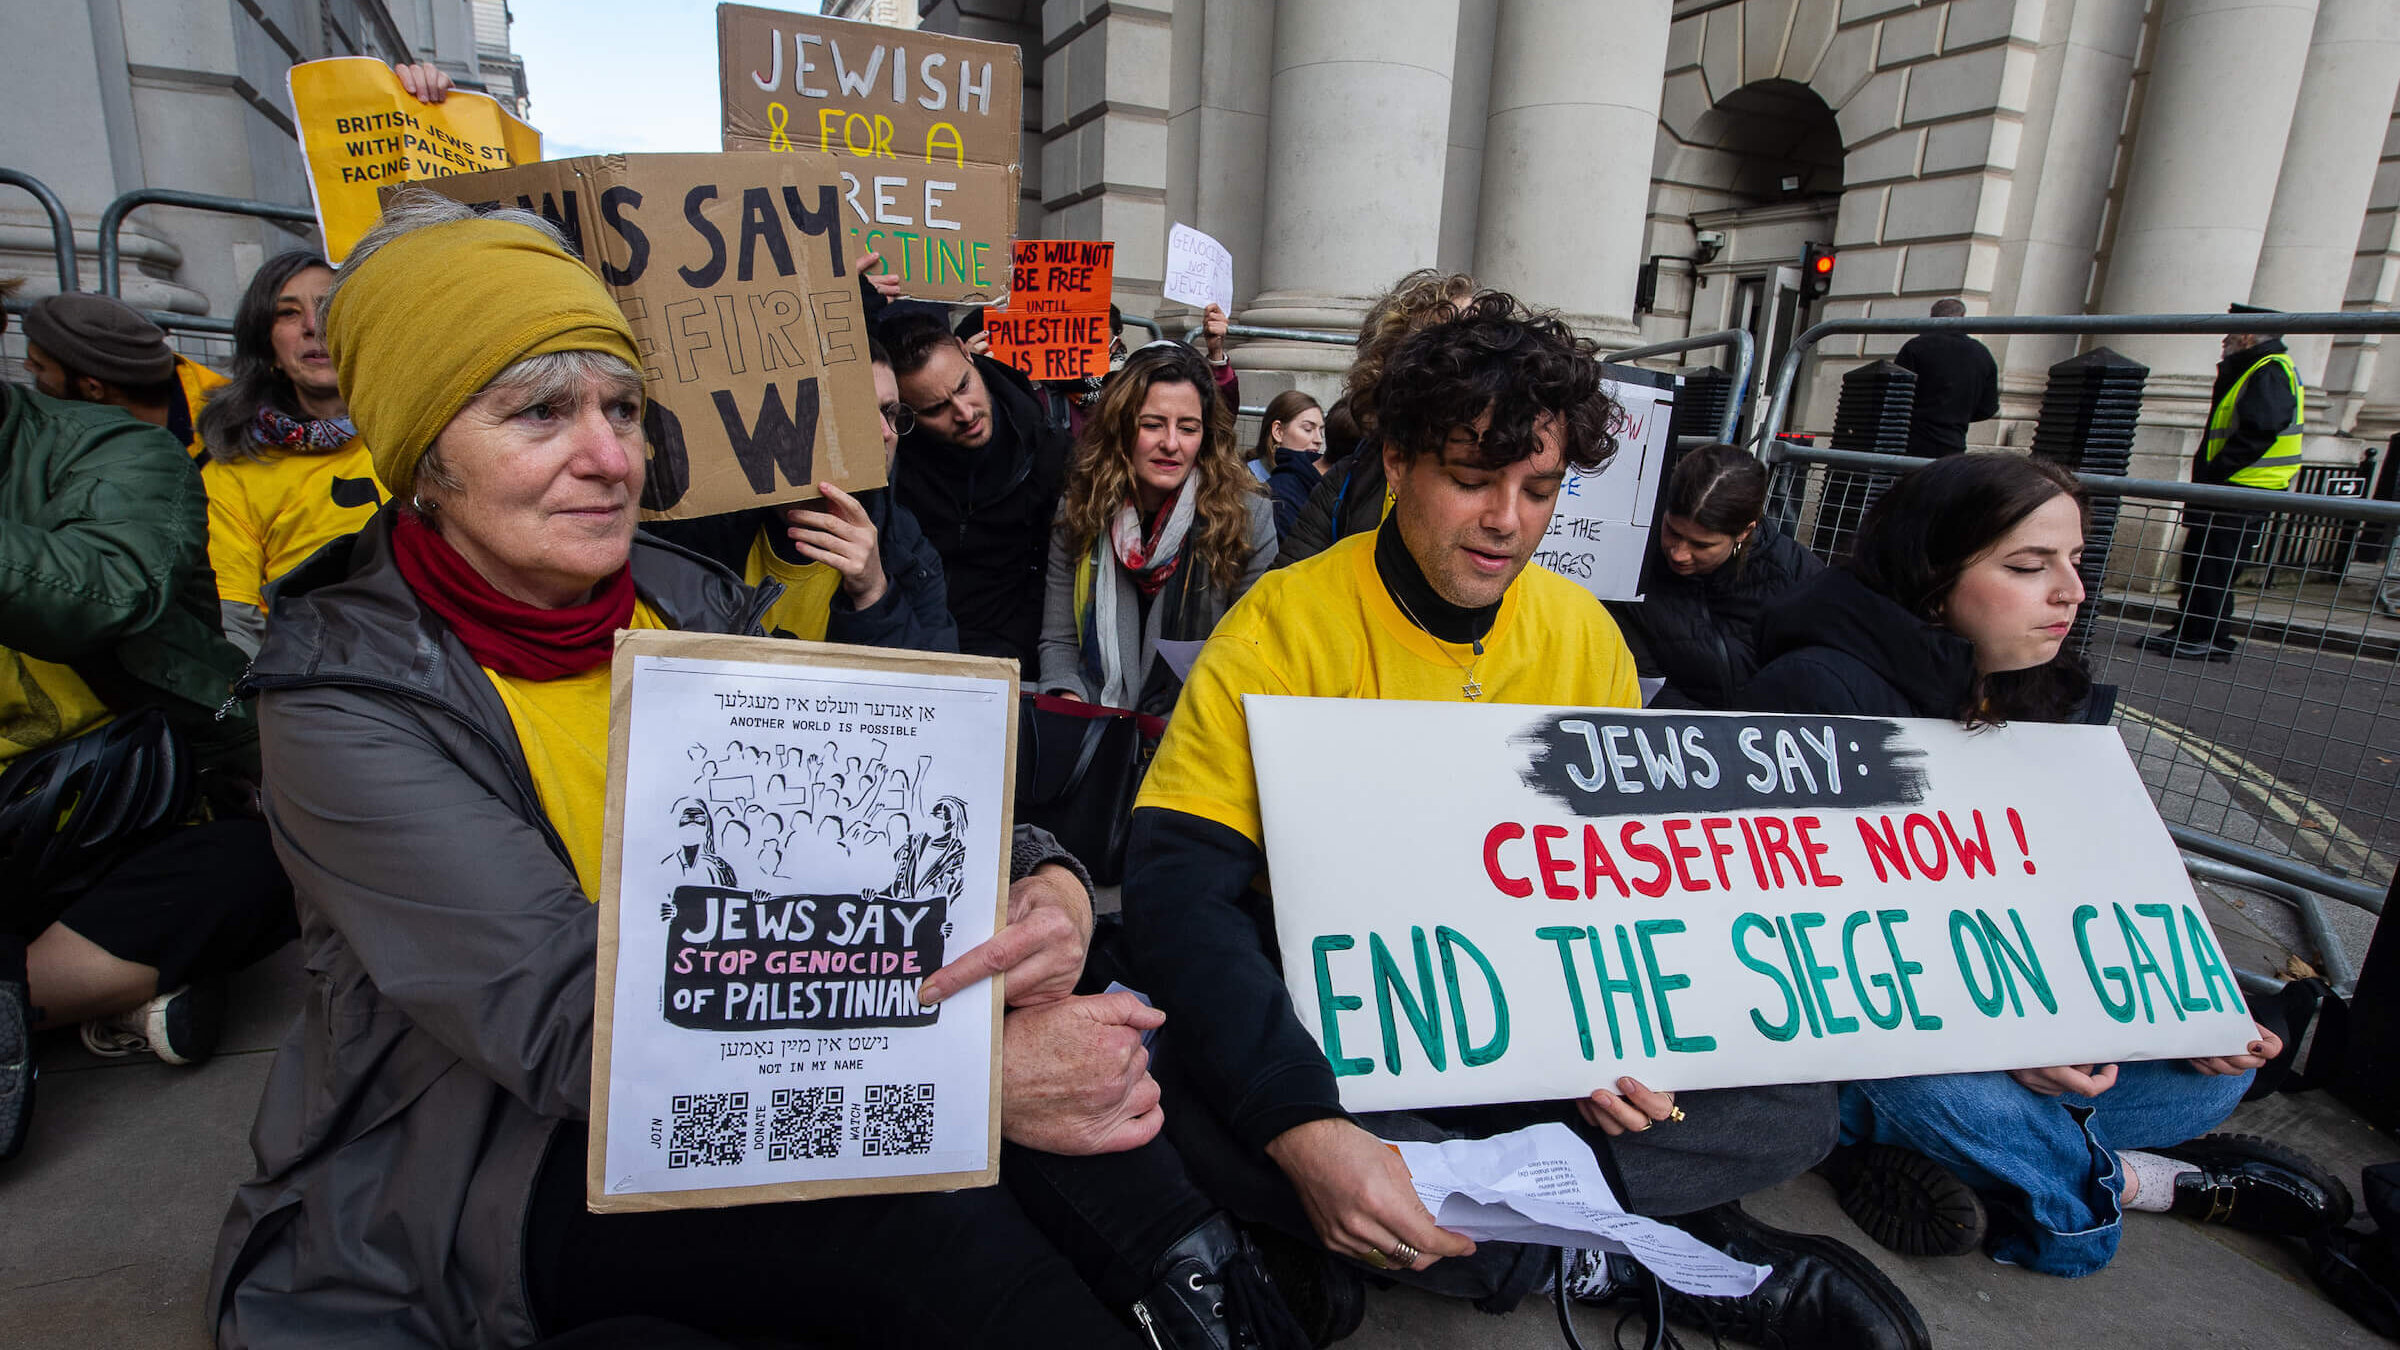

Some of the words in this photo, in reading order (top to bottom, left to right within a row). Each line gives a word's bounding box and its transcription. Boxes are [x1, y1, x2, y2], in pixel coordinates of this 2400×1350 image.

[752, 29, 992, 116] JEWISH
[336, 111, 420, 134] BRITISH
[425, 124, 475, 156] JEWS
[346, 137, 400, 157] WITH
[767, 102, 794, 153] &
[819, 108, 896, 160] FOR
[926, 122, 964, 169] A
[341, 157, 411, 184] FACING
[417, 159, 459, 177] VIO
[840, 171, 961, 230] REE
[678, 185, 845, 289] SAY
[850, 228, 992, 288] STINE
[1012, 243, 1038, 265] WS
[1044, 242, 1077, 264] WILL
[1081, 243, 1114, 269] NOT
[1188, 260, 1209, 274] NOT
[1013, 267, 1040, 292] BE
[1047, 266, 1094, 293] FREE
[1026, 299, 1073, 314] UNTIL
[988, 317, 1104, 346] PALESTINE
[1011, 350, 1033, 377] IS
[1045, 347, 1094, 378] FREE
[641, 377, 820, 511] OW
[1567, 518, 1604, 542] THE
[1533, 550, 1596, 580] TAGES
[714, 690, 780, 711] מעגלעך
[786, 697, 810, 712] איז
[815, 695, 859, 714] וועלט
[729, 716, 786, 729] ANOTHER
[792, 719, 831, 733] WORLD
[839, 722, 853, 733] IS
[859, 724, 918, 737] POSSIBLE
[1559, 720, 1721, 794] JEWS
[1738, 725, 1869, 795] SAY:
[1483, 816, 1844, 901] CEASEFIRE
[681, 897, 817, 944] JEWS
[826, 902, 931, 947] SAY
[673, 947, 758, 975] STOP
[764, 950, 922, 975] GENOCIDE
[672, 988, 716, 1014] OF
[1312, 925, 1510, 1077] END
[1535, 918, 1717, 1061] THE
[1731, 909, 1943, 1042] SIEGE
[1949, 908, 2058, 1019] ON
[2072, 902, 2246, 1024] GAZA
[817, 1037, 842, 1056] אין
[848, 1036, 889, 1052] נישט
[759, 1063, 783, 1075] NOT
[790, 1062, 804, 1073] IN
[811, 1060, 827, 1071] MY
[834, 1059, 864, 1071] NAME
[651, 1117, 663, 1149] JOIN
[753, 1104, 767, 1150] DONATE
[850, 1102, 862, 1141] WATCH
